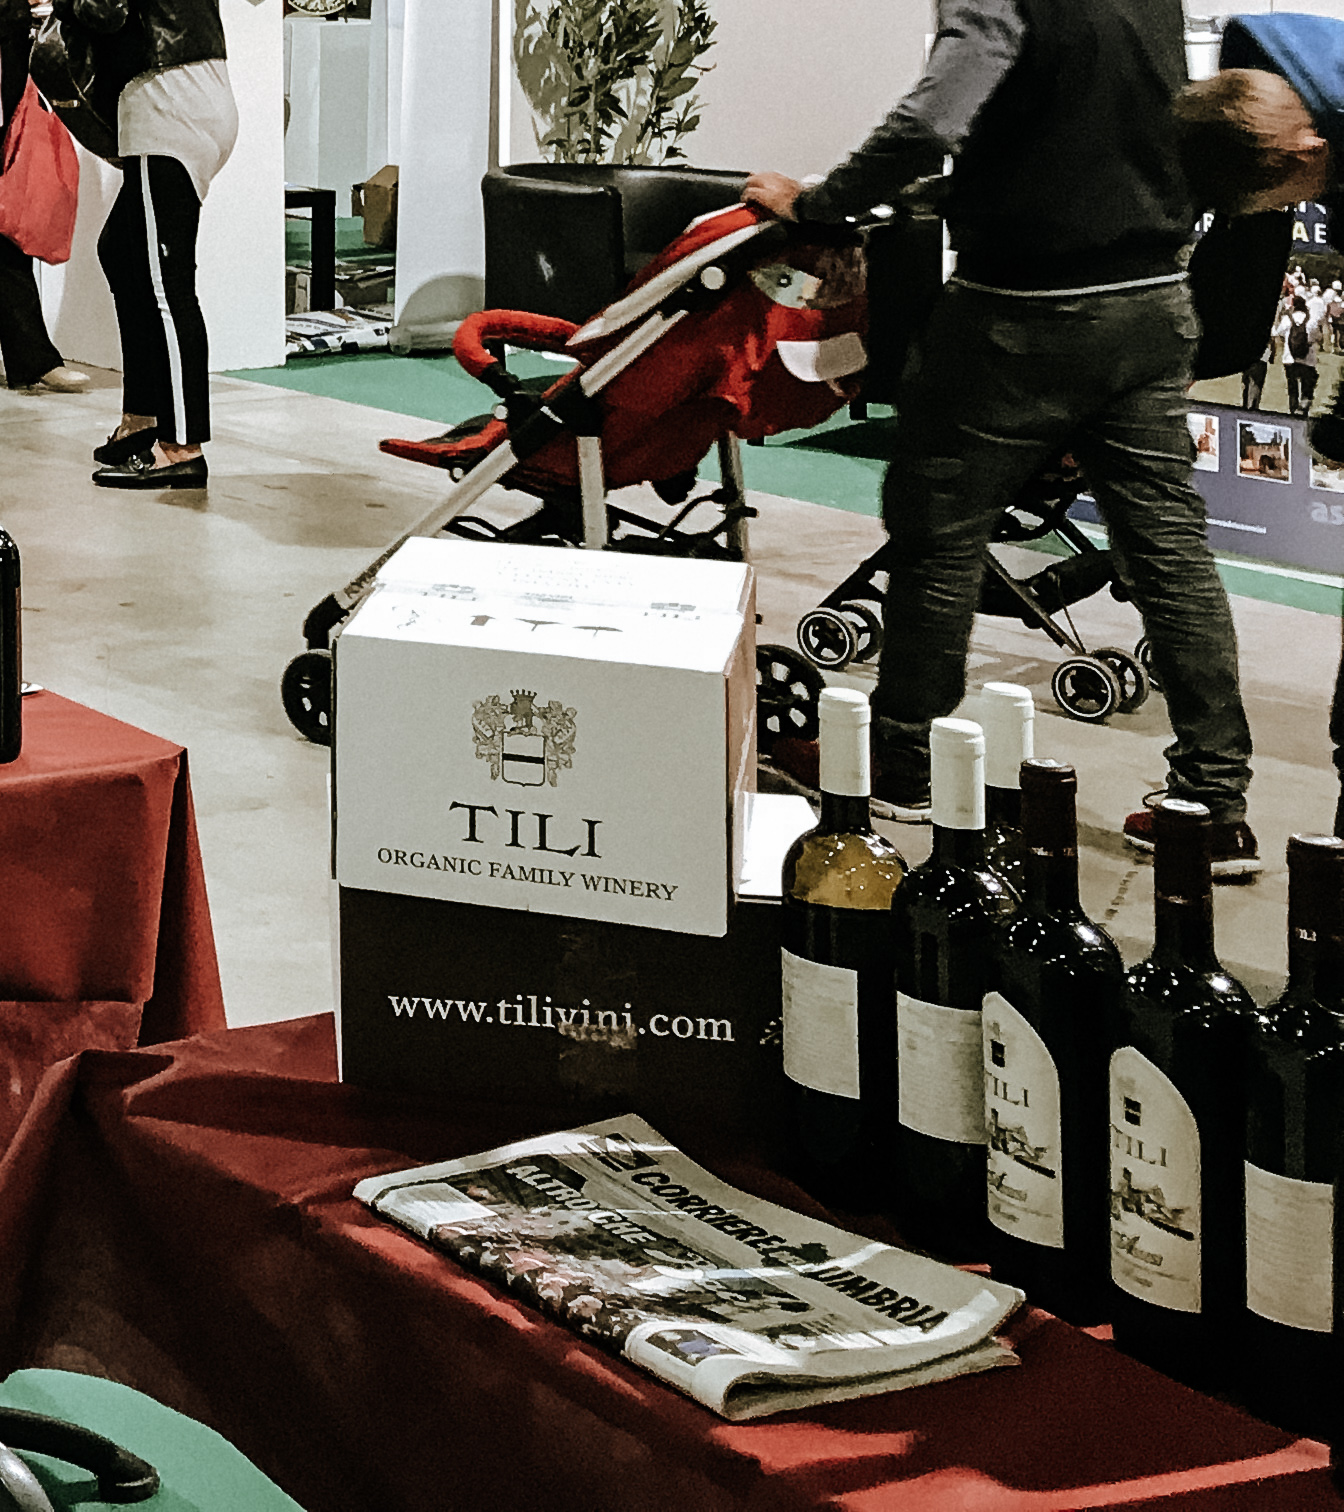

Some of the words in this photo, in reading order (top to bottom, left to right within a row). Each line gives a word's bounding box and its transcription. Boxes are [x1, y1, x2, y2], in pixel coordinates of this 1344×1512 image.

[449, 800, 603, 859] TILI
[377, 847, 483, 876] ORGANIC
[487, 861, 576, 888] FAMILY
[579, 873, 679, 901] WINERY
[388, 993, 736, 1043] www.tilivini.com
[506, 1164, 601, 1210] ALTRO
[587, 1210, 658, 1245] CHE
[631, 1171, 788, 1250] CORRIERE
[798, 1265, 949, 1334] UMBRIA
